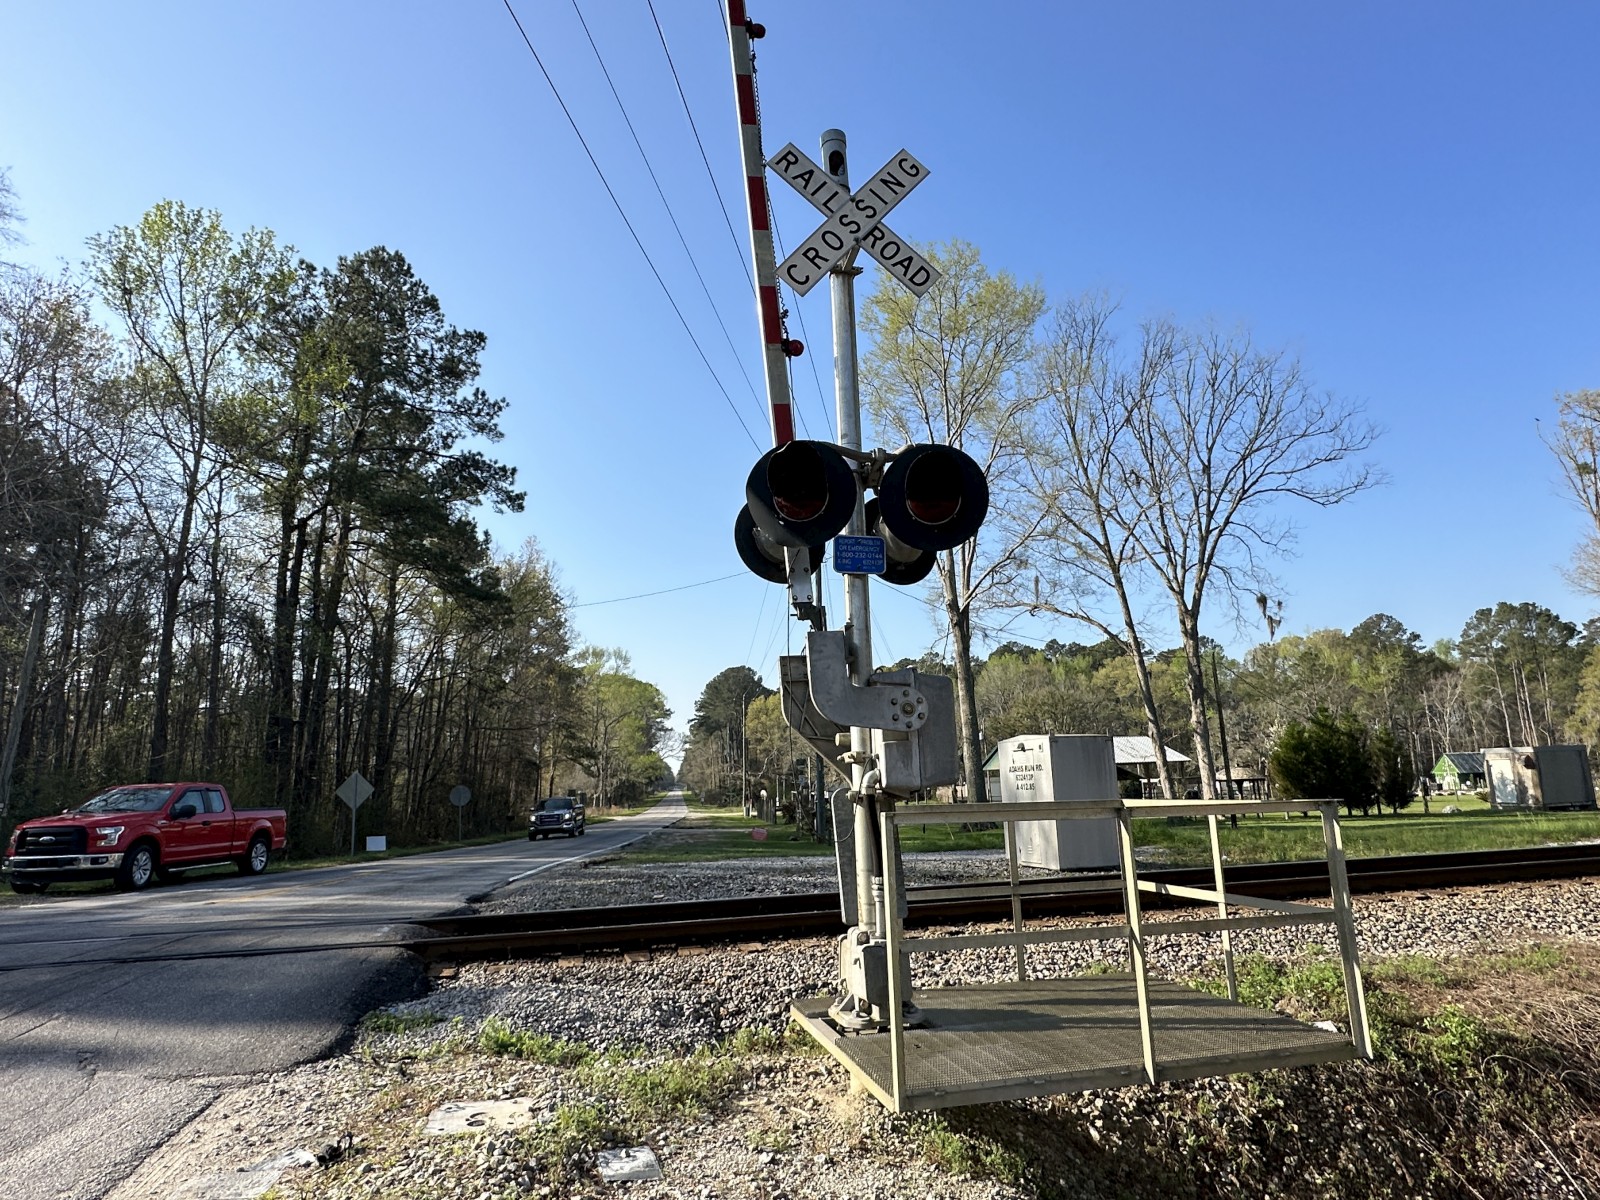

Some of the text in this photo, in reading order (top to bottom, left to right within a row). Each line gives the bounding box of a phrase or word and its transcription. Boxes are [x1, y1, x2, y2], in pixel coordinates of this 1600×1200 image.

[775, 150, 839, 214] RAIL
[786, 158, 920, 286] CROSSING
[862, 226, 930, 287] ROAD
[1008, 765, 1024, 773] ADAMS
[1025, 764, 1035, 772] RUN
